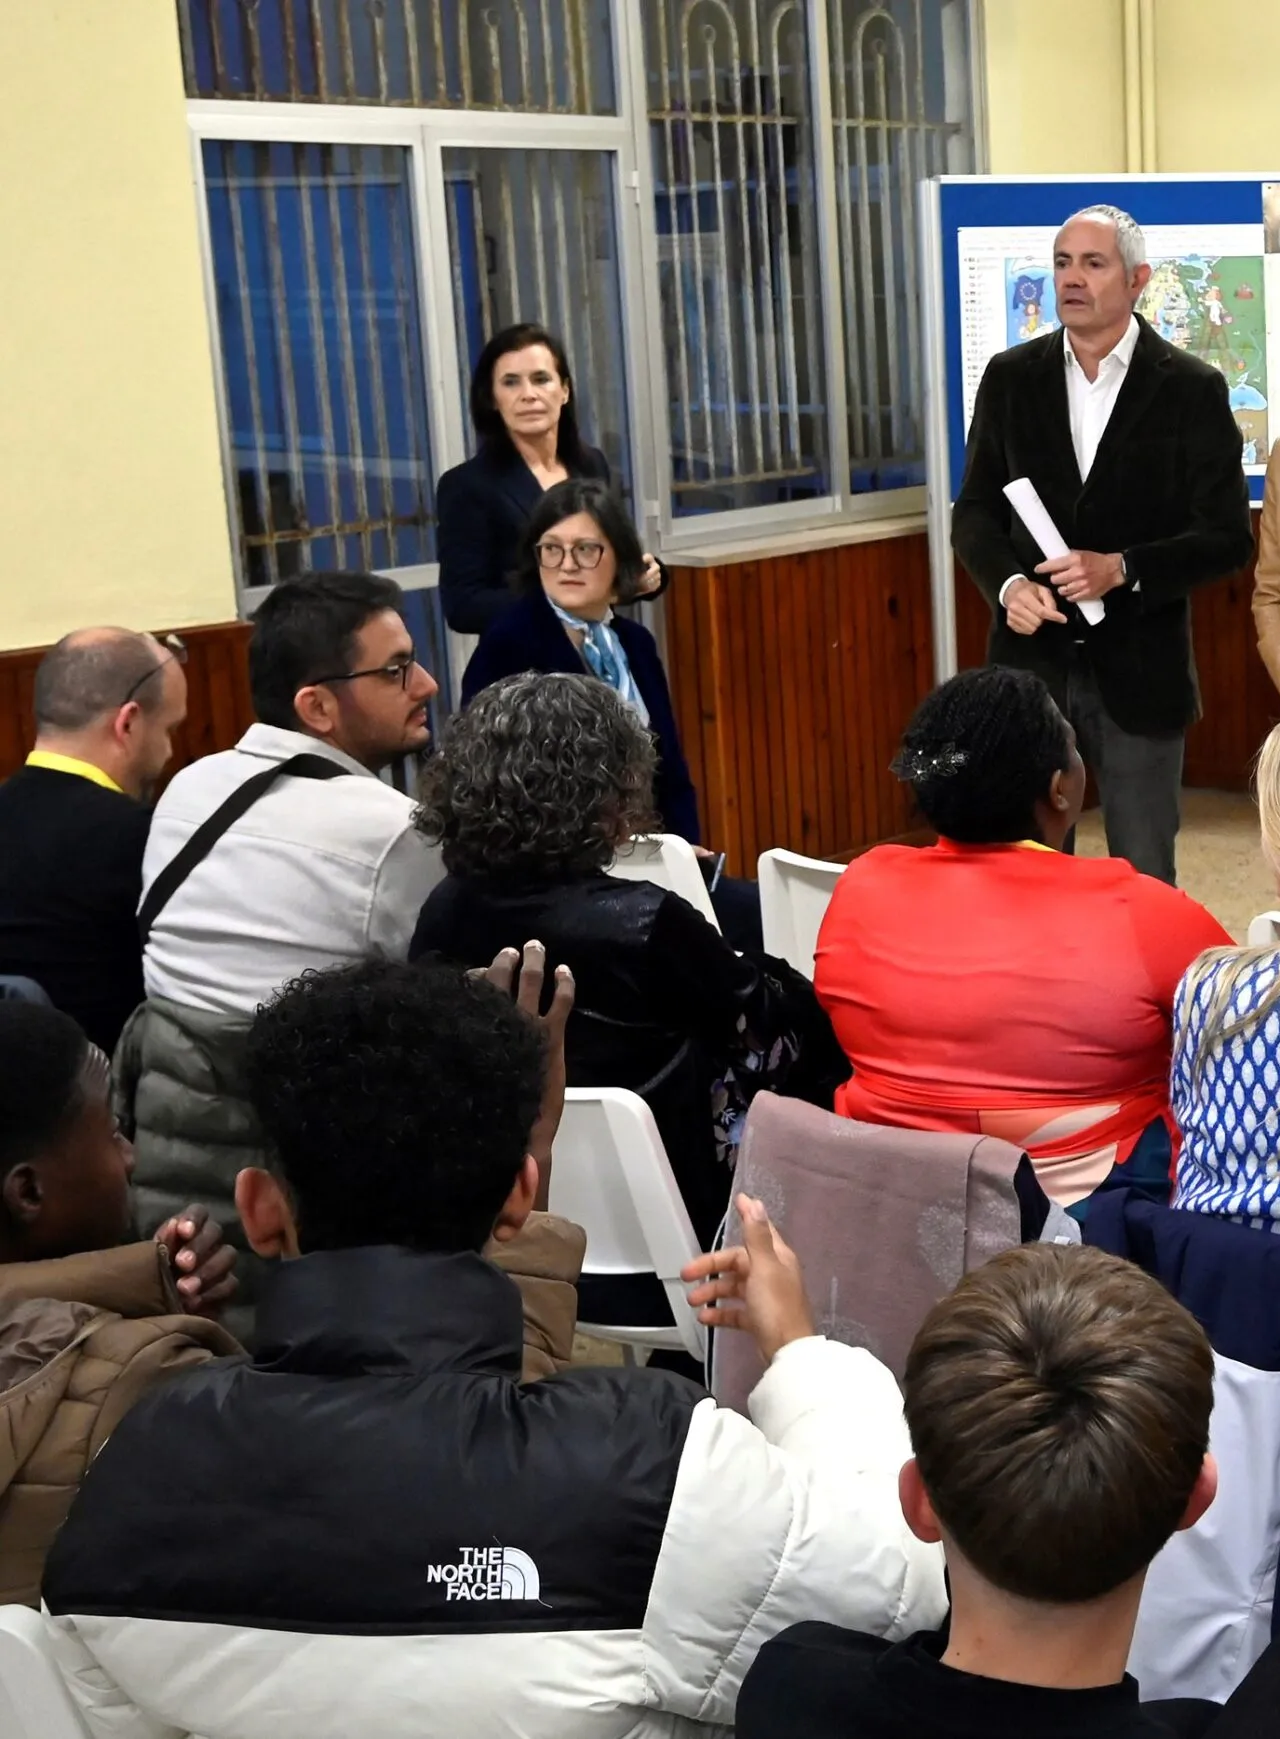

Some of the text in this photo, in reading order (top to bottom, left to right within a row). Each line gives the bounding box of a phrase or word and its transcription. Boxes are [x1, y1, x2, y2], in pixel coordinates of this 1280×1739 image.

[459, 1547, 502, 1565] THE
[427, 1564, 502, 1583] NORTH
[446, 1582, 502, 1601] FACE
